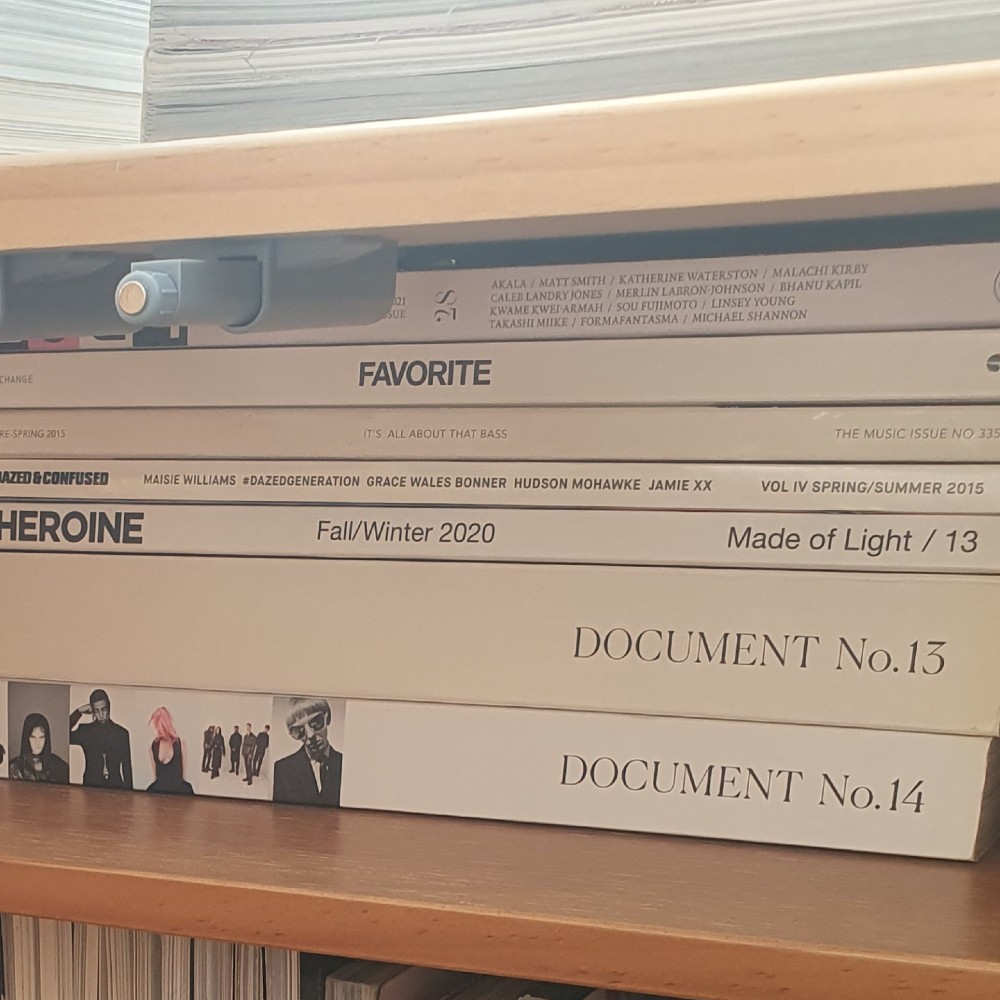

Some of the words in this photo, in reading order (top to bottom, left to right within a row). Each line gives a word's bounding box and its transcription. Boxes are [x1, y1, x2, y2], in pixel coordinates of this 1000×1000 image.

[492, 279, 527, 290] AKALA
[539, 277, 569, 287] MATT
[571, 276, 606, 287] SMITH
[619, 272, 685, 286] KATHERINE
[688, 269, 758, 282] WATERSTON
[772, 265, 828, 278] MALACHI
[831, 263, 869, 276] KIRBY
[491, 292, 526, 304] CALEB
[525, 290, 569, 302] LANDRY
[569, 289, 603, 302] JONES
[616, 287, 660, 299] MERLIN
[661, 282, 765, 297] LABRON-JOHNSON
[779, 279, 824, 292] BHANU
[825, 278, 862, 290] KAPIL
[490, 304, 529, 317] KWAME
[531, 303, 603, 315] KWEI-ARMAH
[616, 300, 639, 312] SOU
[641, 299, 697, 312] FUJIMOTO
[711, 297, 752, 309] LINSEY
[754, 296, 795, 307] YOUNG
[0, 375, 32, 384] CHANGE
[359, 360, 492, 386] FAVORITE
[46, 429, 65, 438] 2015
[364, 428, 382, 438] IT'S
[387, 429, 407, 438] ALL
[409, 429, 447, 438] ABOUT
[449, 429, 477, 438] THAT
[480, 429, 507, 439] BASS
[835, 428, 860, 439] THE
[864, 428, 906, 439] MUSIC
[910, 428, 948, 439] ISSUE
[952, 428, 975, 439] NO
[978, 428, 1000, 439] 335
[144, 474, 180, 485] MAISIE
[183, 475, 236, 485] WILLIAMS
[243, 476, 360, 486] #DAZEDGENERATION
[367, 476, 407, 487] GRACE
[410, 477, 451, 487] WALES
[455, 477, 506, 488] BONNER
[514, 478, 568, 489] HUDSON
[572, 478, 641, 490] MOHAWKE
[648, 479, 690, 491] JAMIE
[693, 480, 712, 491] XX
[762, 481, 788, 492] VOL
[794, 481, 808, 492] IV
[812, 481, 942, 494] SPRING/SUMMER
[947, 482, 984, 494] 2015
[317, 520, 433, 542] Fall/Winter
[439, 522, 495, 543] 2020
[728, 527, 800, 549] Made
[810, 528, 837, 550] of
[844, 528, 913, 557] Light
[946, 530, 978, 553] 13
[574, 627, 819, 668] DOCUMENT
[836, 637, 946, 675] No.13
[561, 755, 803, 802] DOCUMENT
[819, 774, 924, 813] No.14
